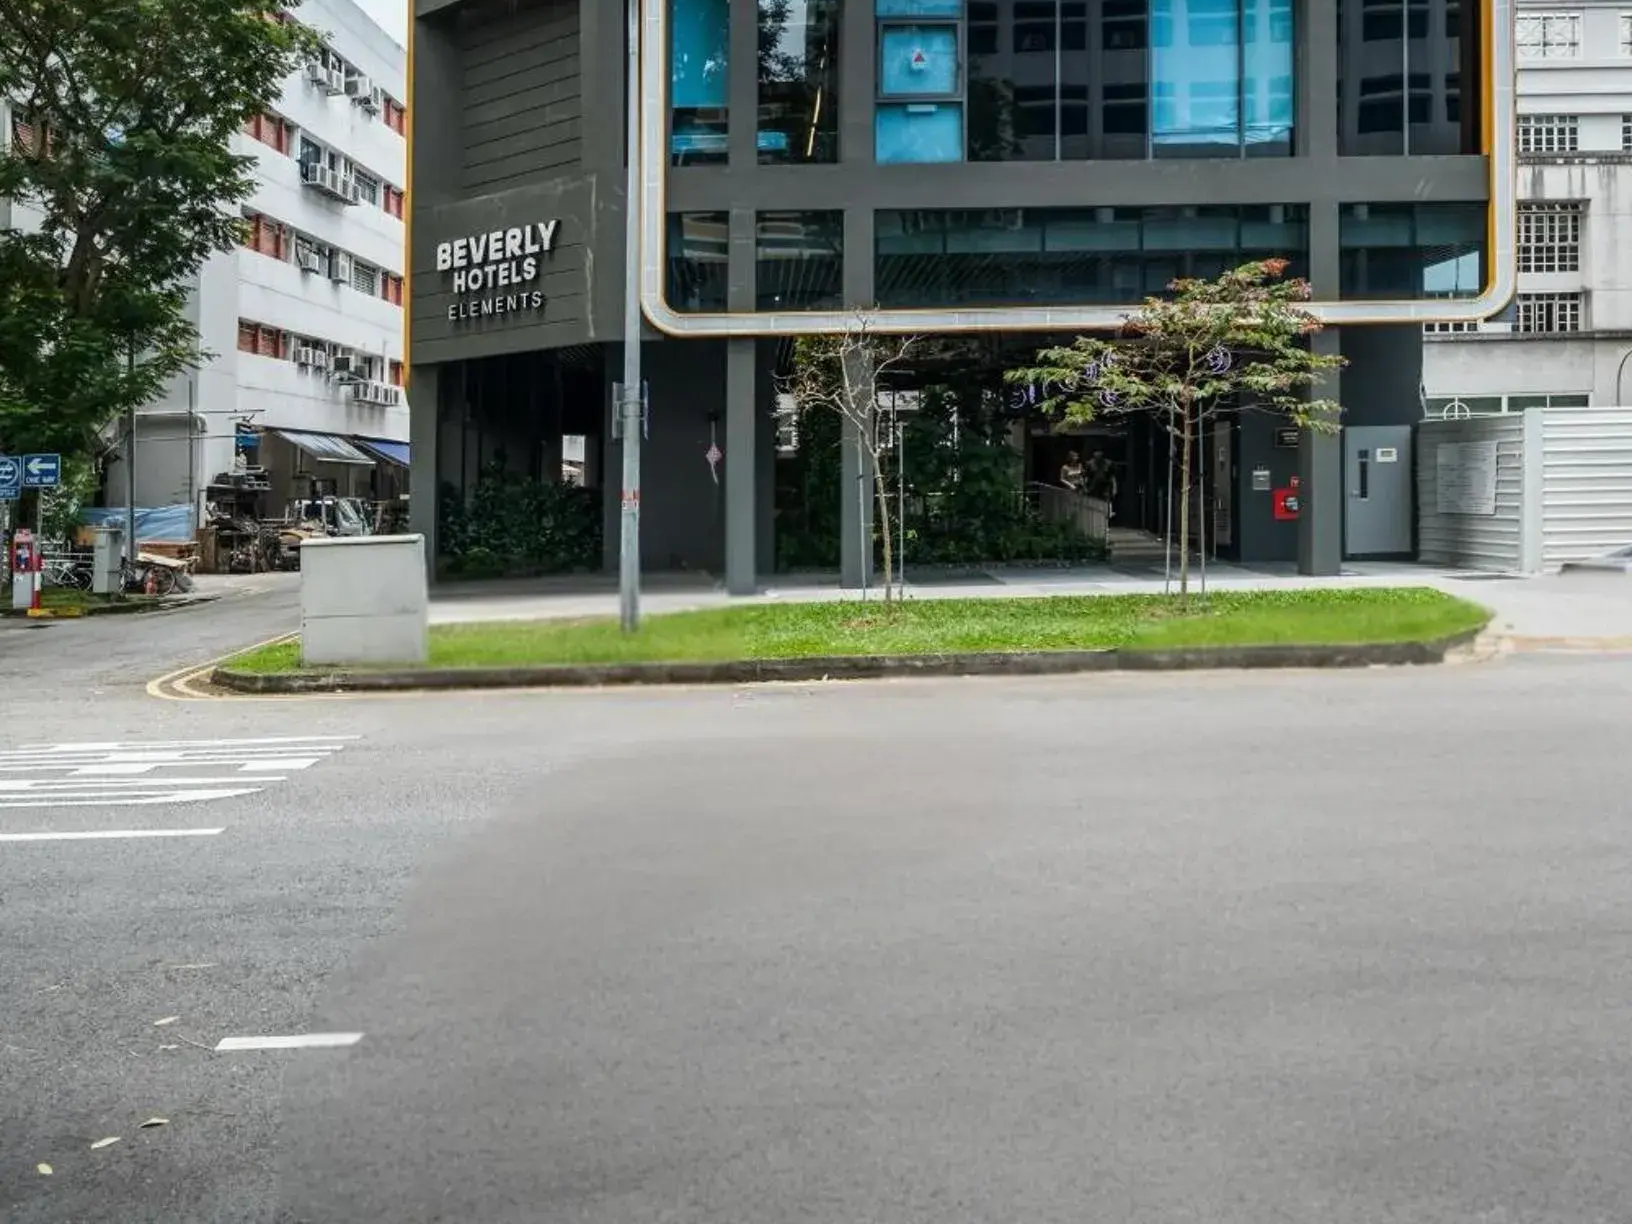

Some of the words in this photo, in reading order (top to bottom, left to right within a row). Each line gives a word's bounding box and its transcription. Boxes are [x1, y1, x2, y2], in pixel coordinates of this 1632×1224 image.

[436, 219, 558, 271] BEVERLY
[453, 256, 537, 293] HOTELS
[447, 290, 543, 321] ELEMENTS
